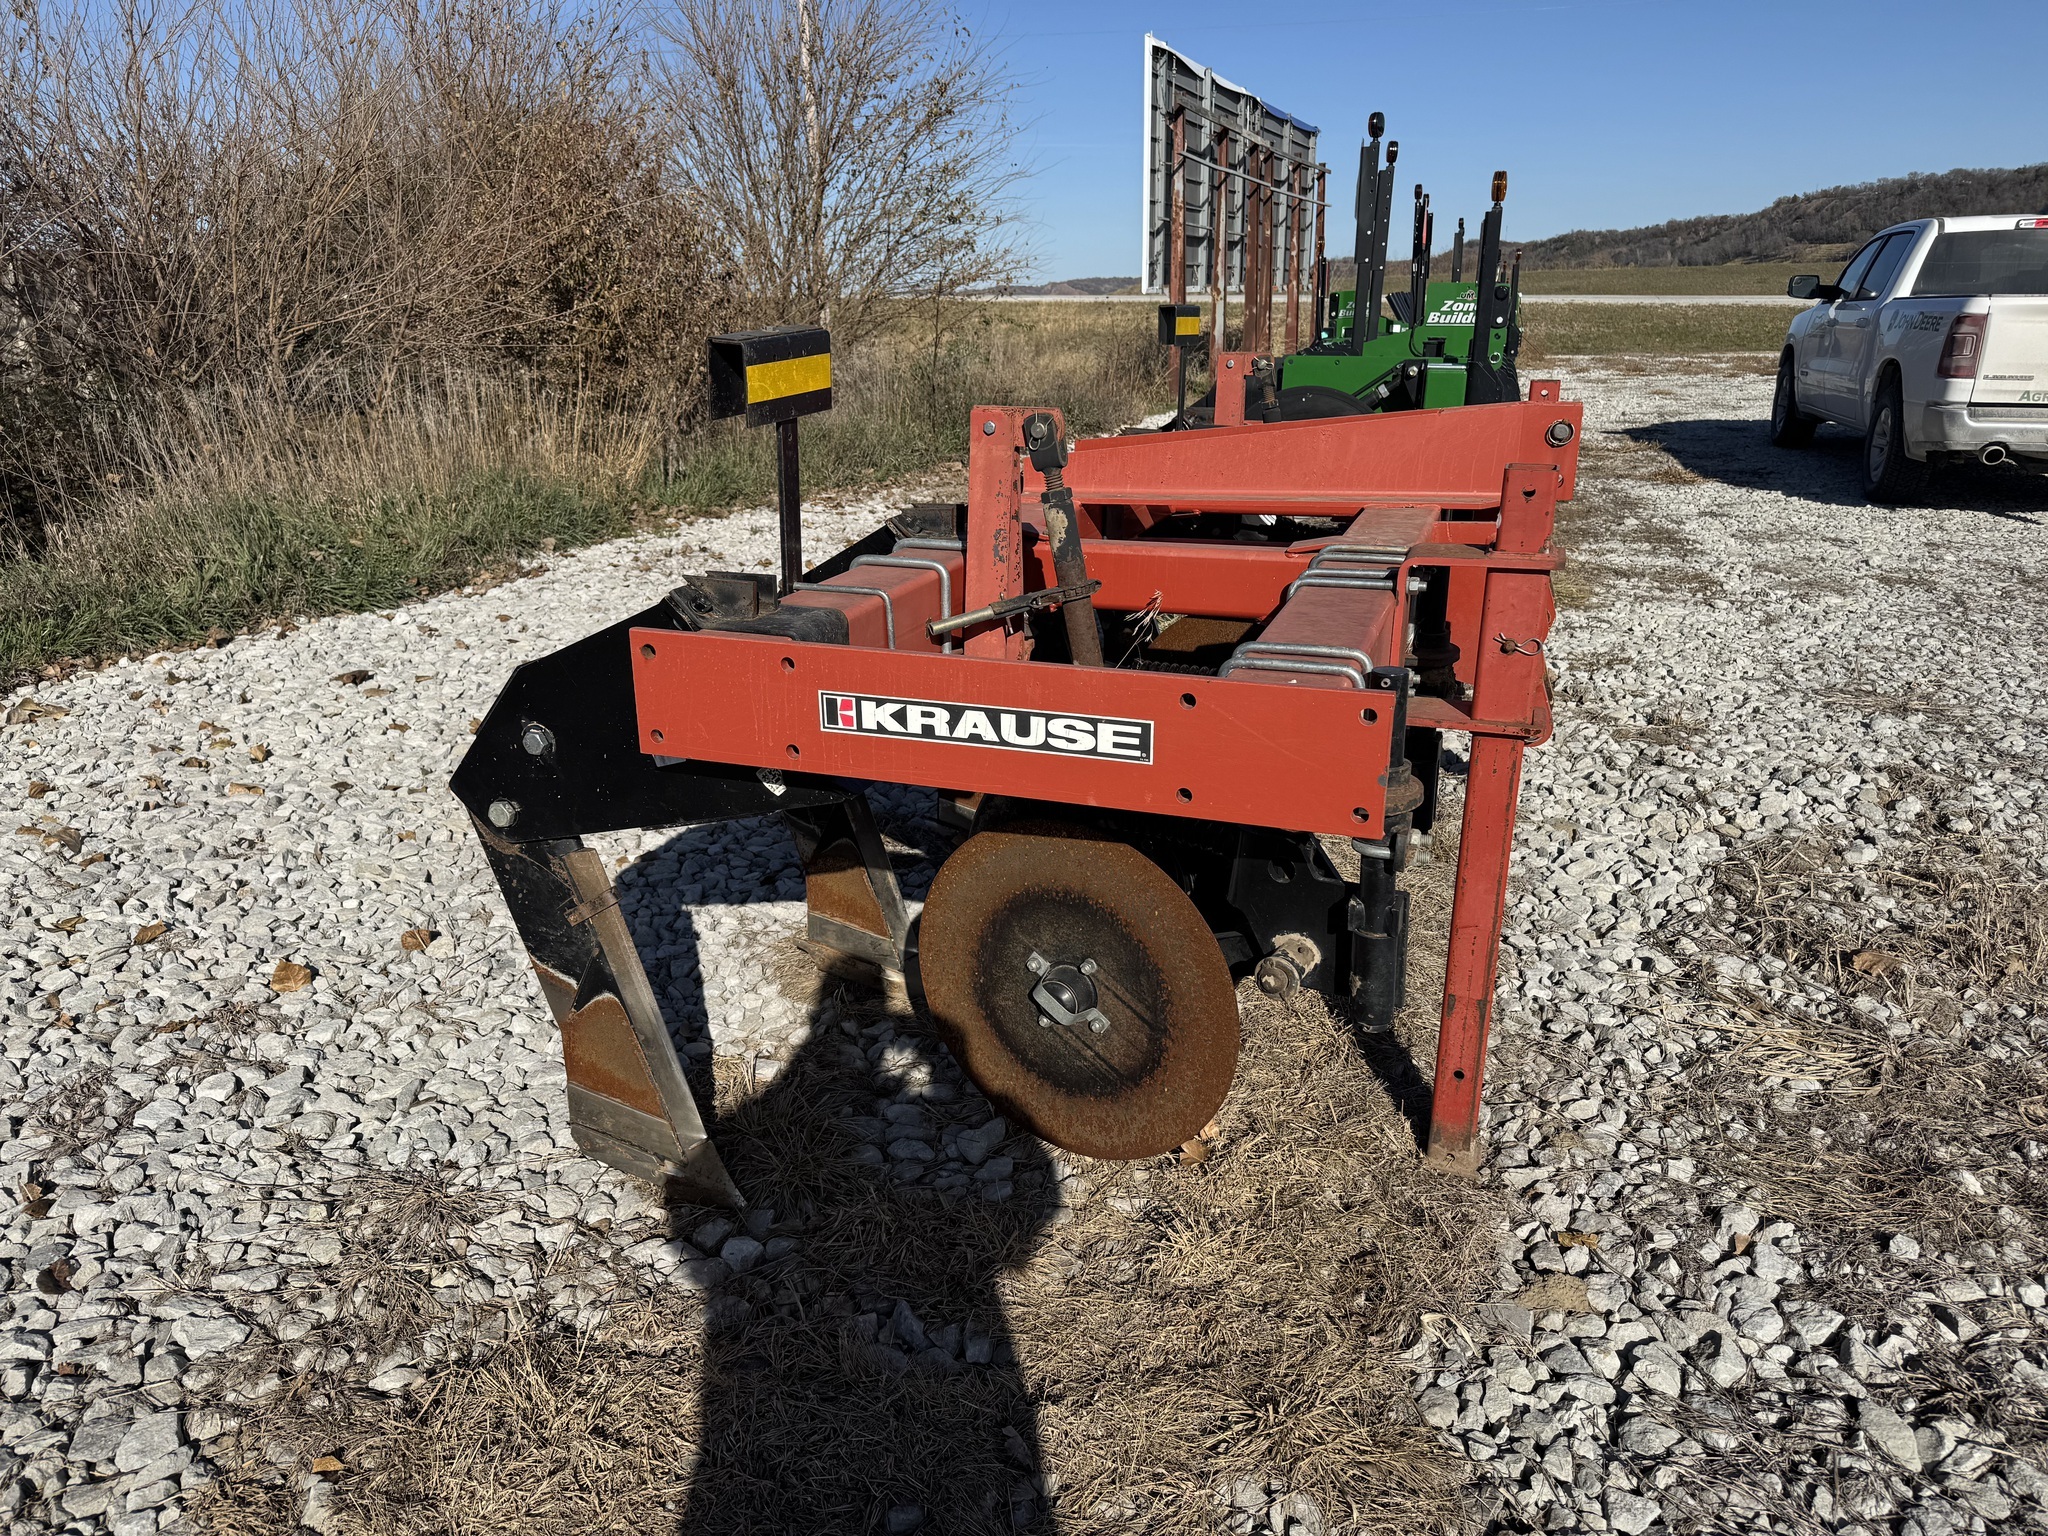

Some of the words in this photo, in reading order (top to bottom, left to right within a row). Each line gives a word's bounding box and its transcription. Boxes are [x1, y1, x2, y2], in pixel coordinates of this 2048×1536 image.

[1440, 300, 1476, 311] Zon
[1427, 311, 1475, 324] Build
[1913, 311, 1943, 332] DEERE
[860, 700, 1142, 757] KRAUSE
